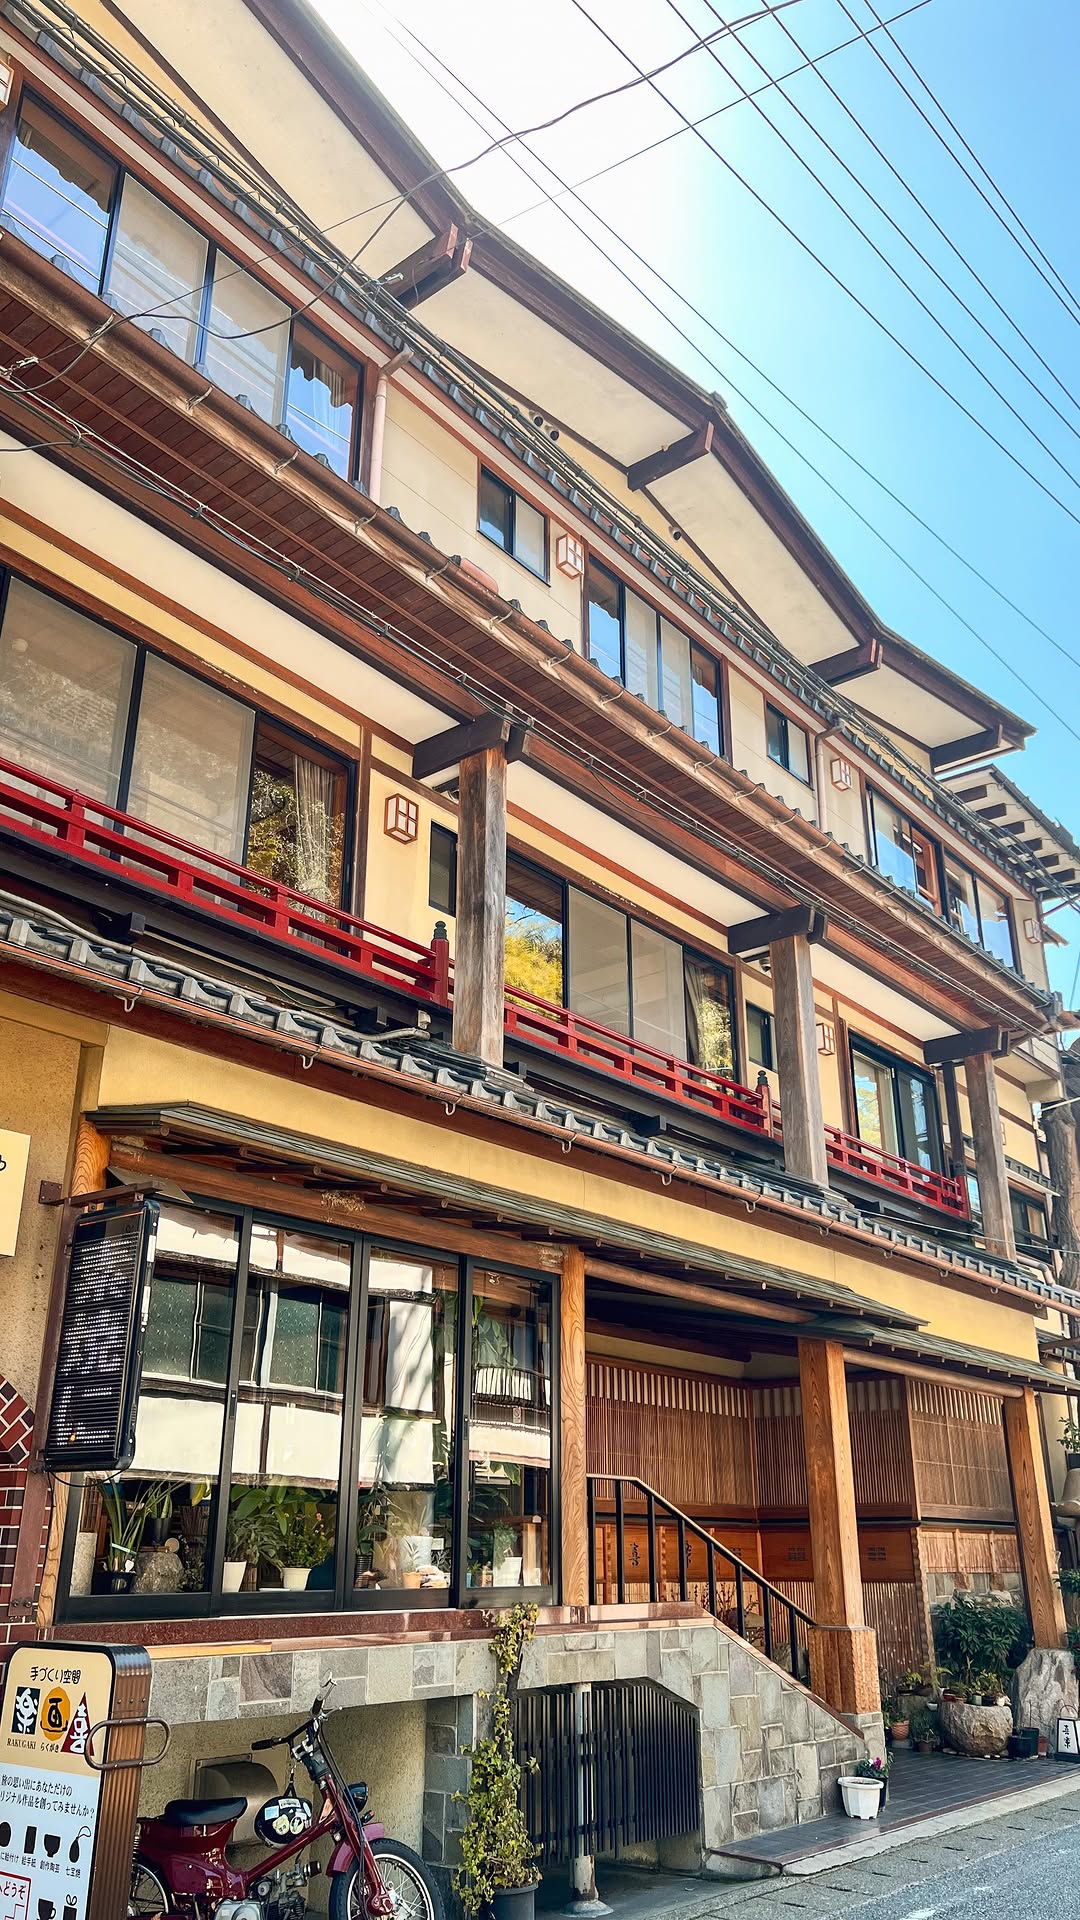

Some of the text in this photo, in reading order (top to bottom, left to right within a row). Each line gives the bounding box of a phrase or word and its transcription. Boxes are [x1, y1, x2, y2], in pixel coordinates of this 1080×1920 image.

[30, 1666, 81, 1684] 手づくり空間
[7, 1738, 36, 1750] RAKUGAKI
[40, 1742, 59, 1753] らくがき
[1, 1774, 73, 1796] 旅の思い出にあなただけの
